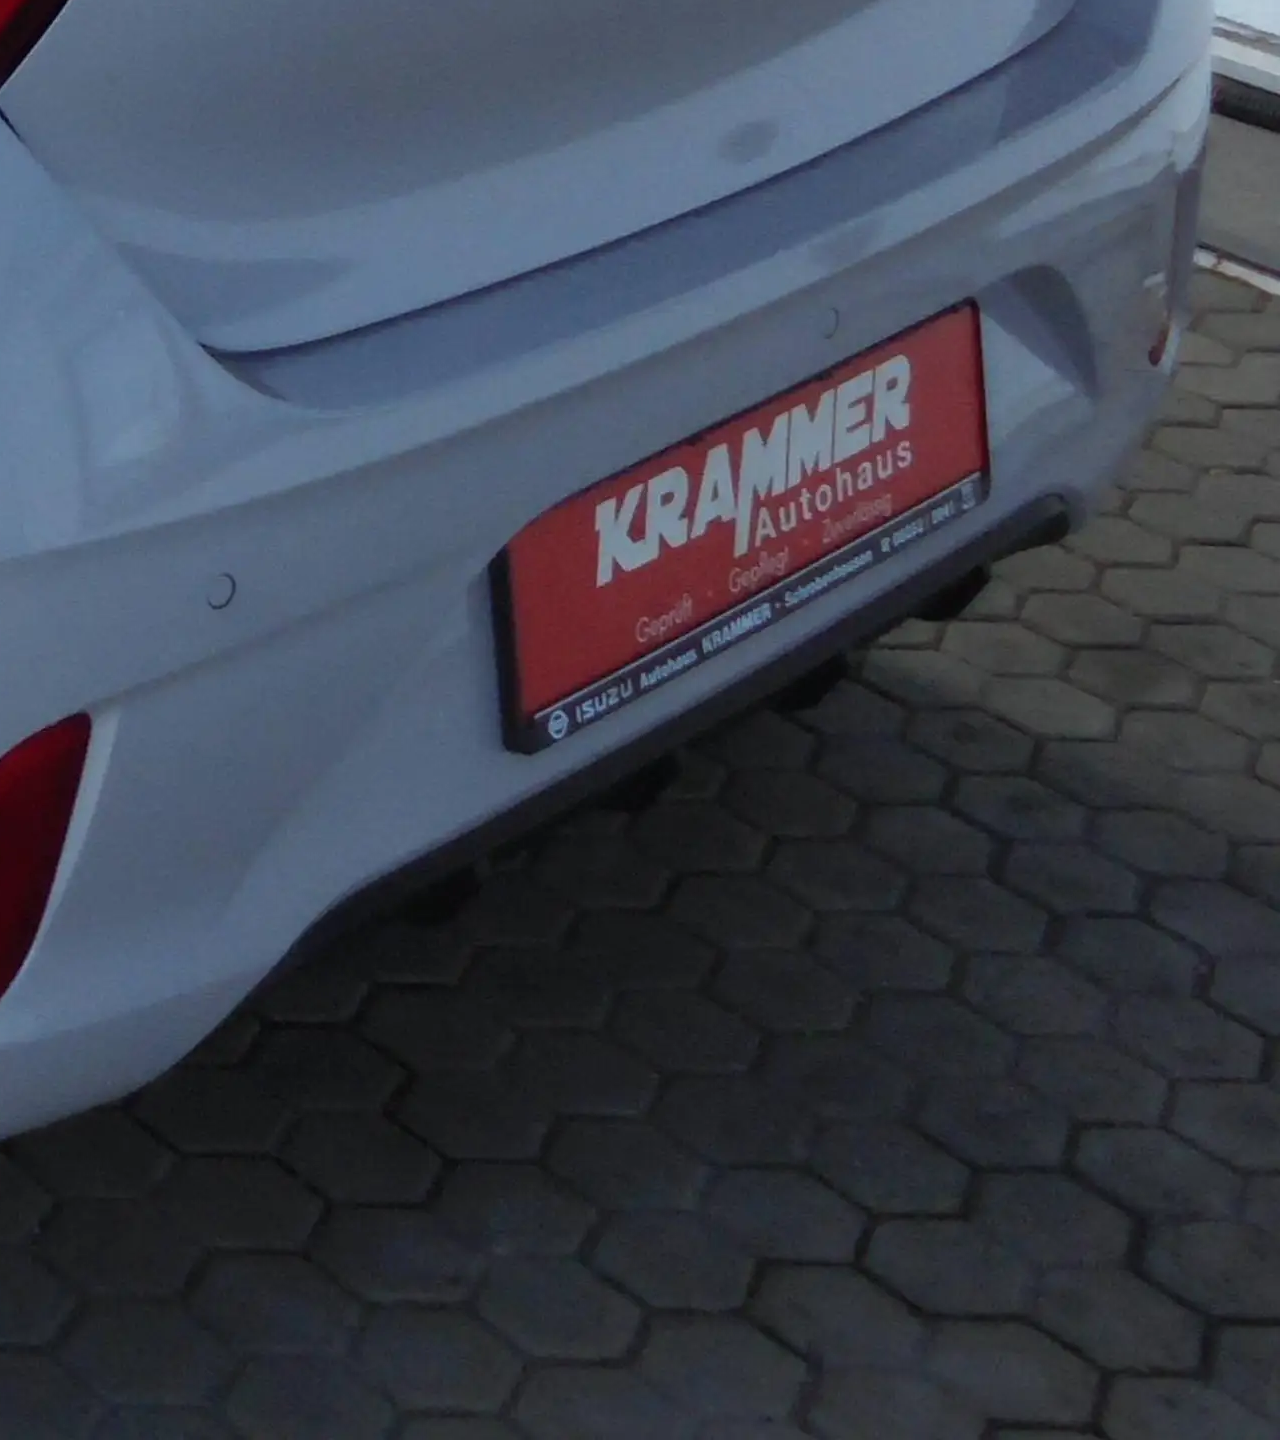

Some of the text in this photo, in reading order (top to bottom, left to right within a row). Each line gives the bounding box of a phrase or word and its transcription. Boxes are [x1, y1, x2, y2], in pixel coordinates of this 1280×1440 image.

[595, 355, 911, 588] KRAMMER
[755, 440, 913, 548] Autohaus
[575, 679, 633, 724] ISUZU
[640, 648, 698, 690] Autohaus
[701, 603, 772, 654] KRAMMER
